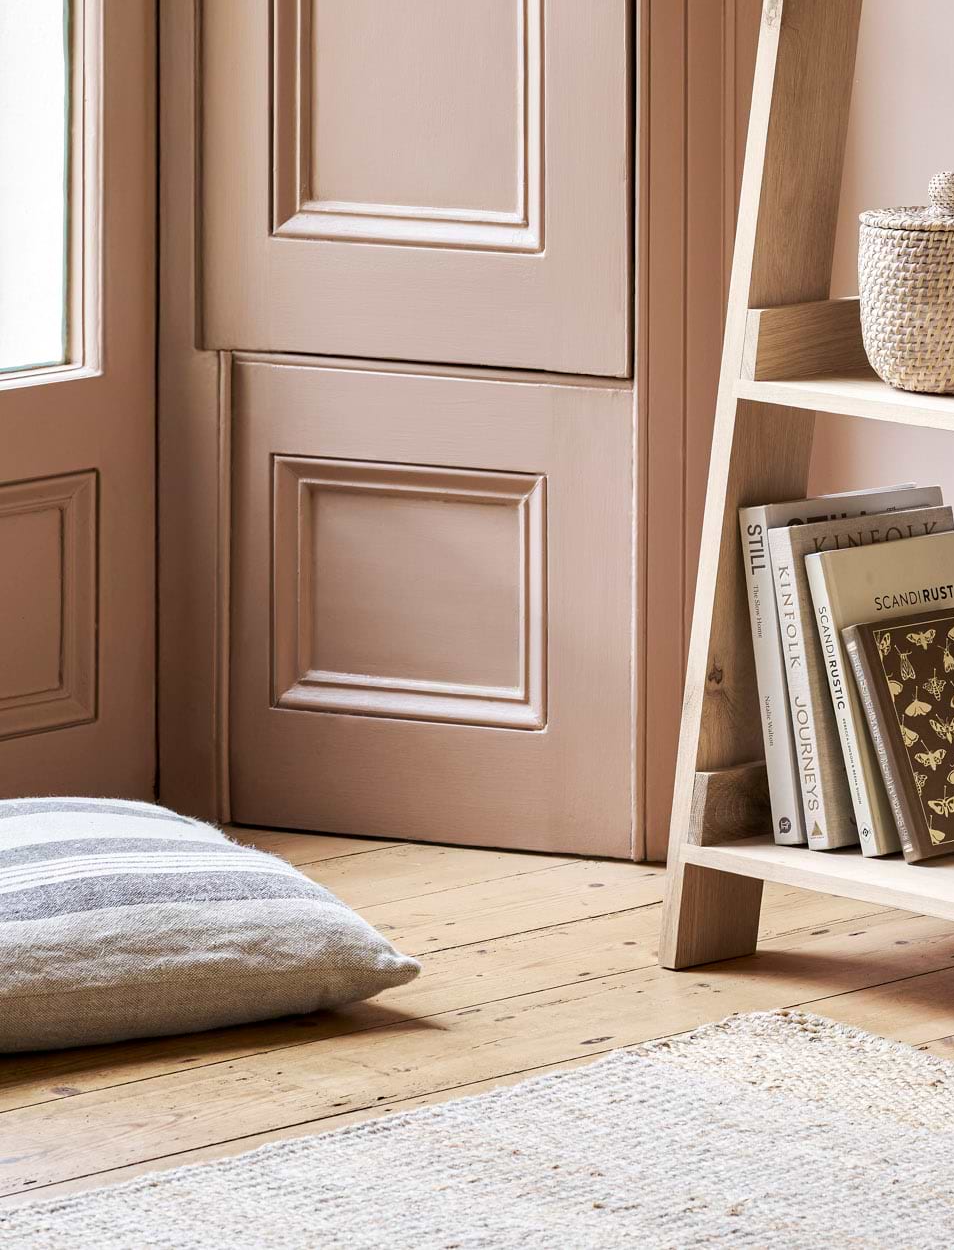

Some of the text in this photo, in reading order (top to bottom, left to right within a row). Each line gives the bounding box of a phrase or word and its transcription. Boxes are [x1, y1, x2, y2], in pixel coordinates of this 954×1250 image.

[747, 524, 766, 575] STILL
[778, 566, 801, 669] KINFOLK
[794, 696, 820, 811] JOURNEYS
[818, 606, 846, 710] SCANDIRUSTIC
[764, 695, 775, 747] Natalie Walton
